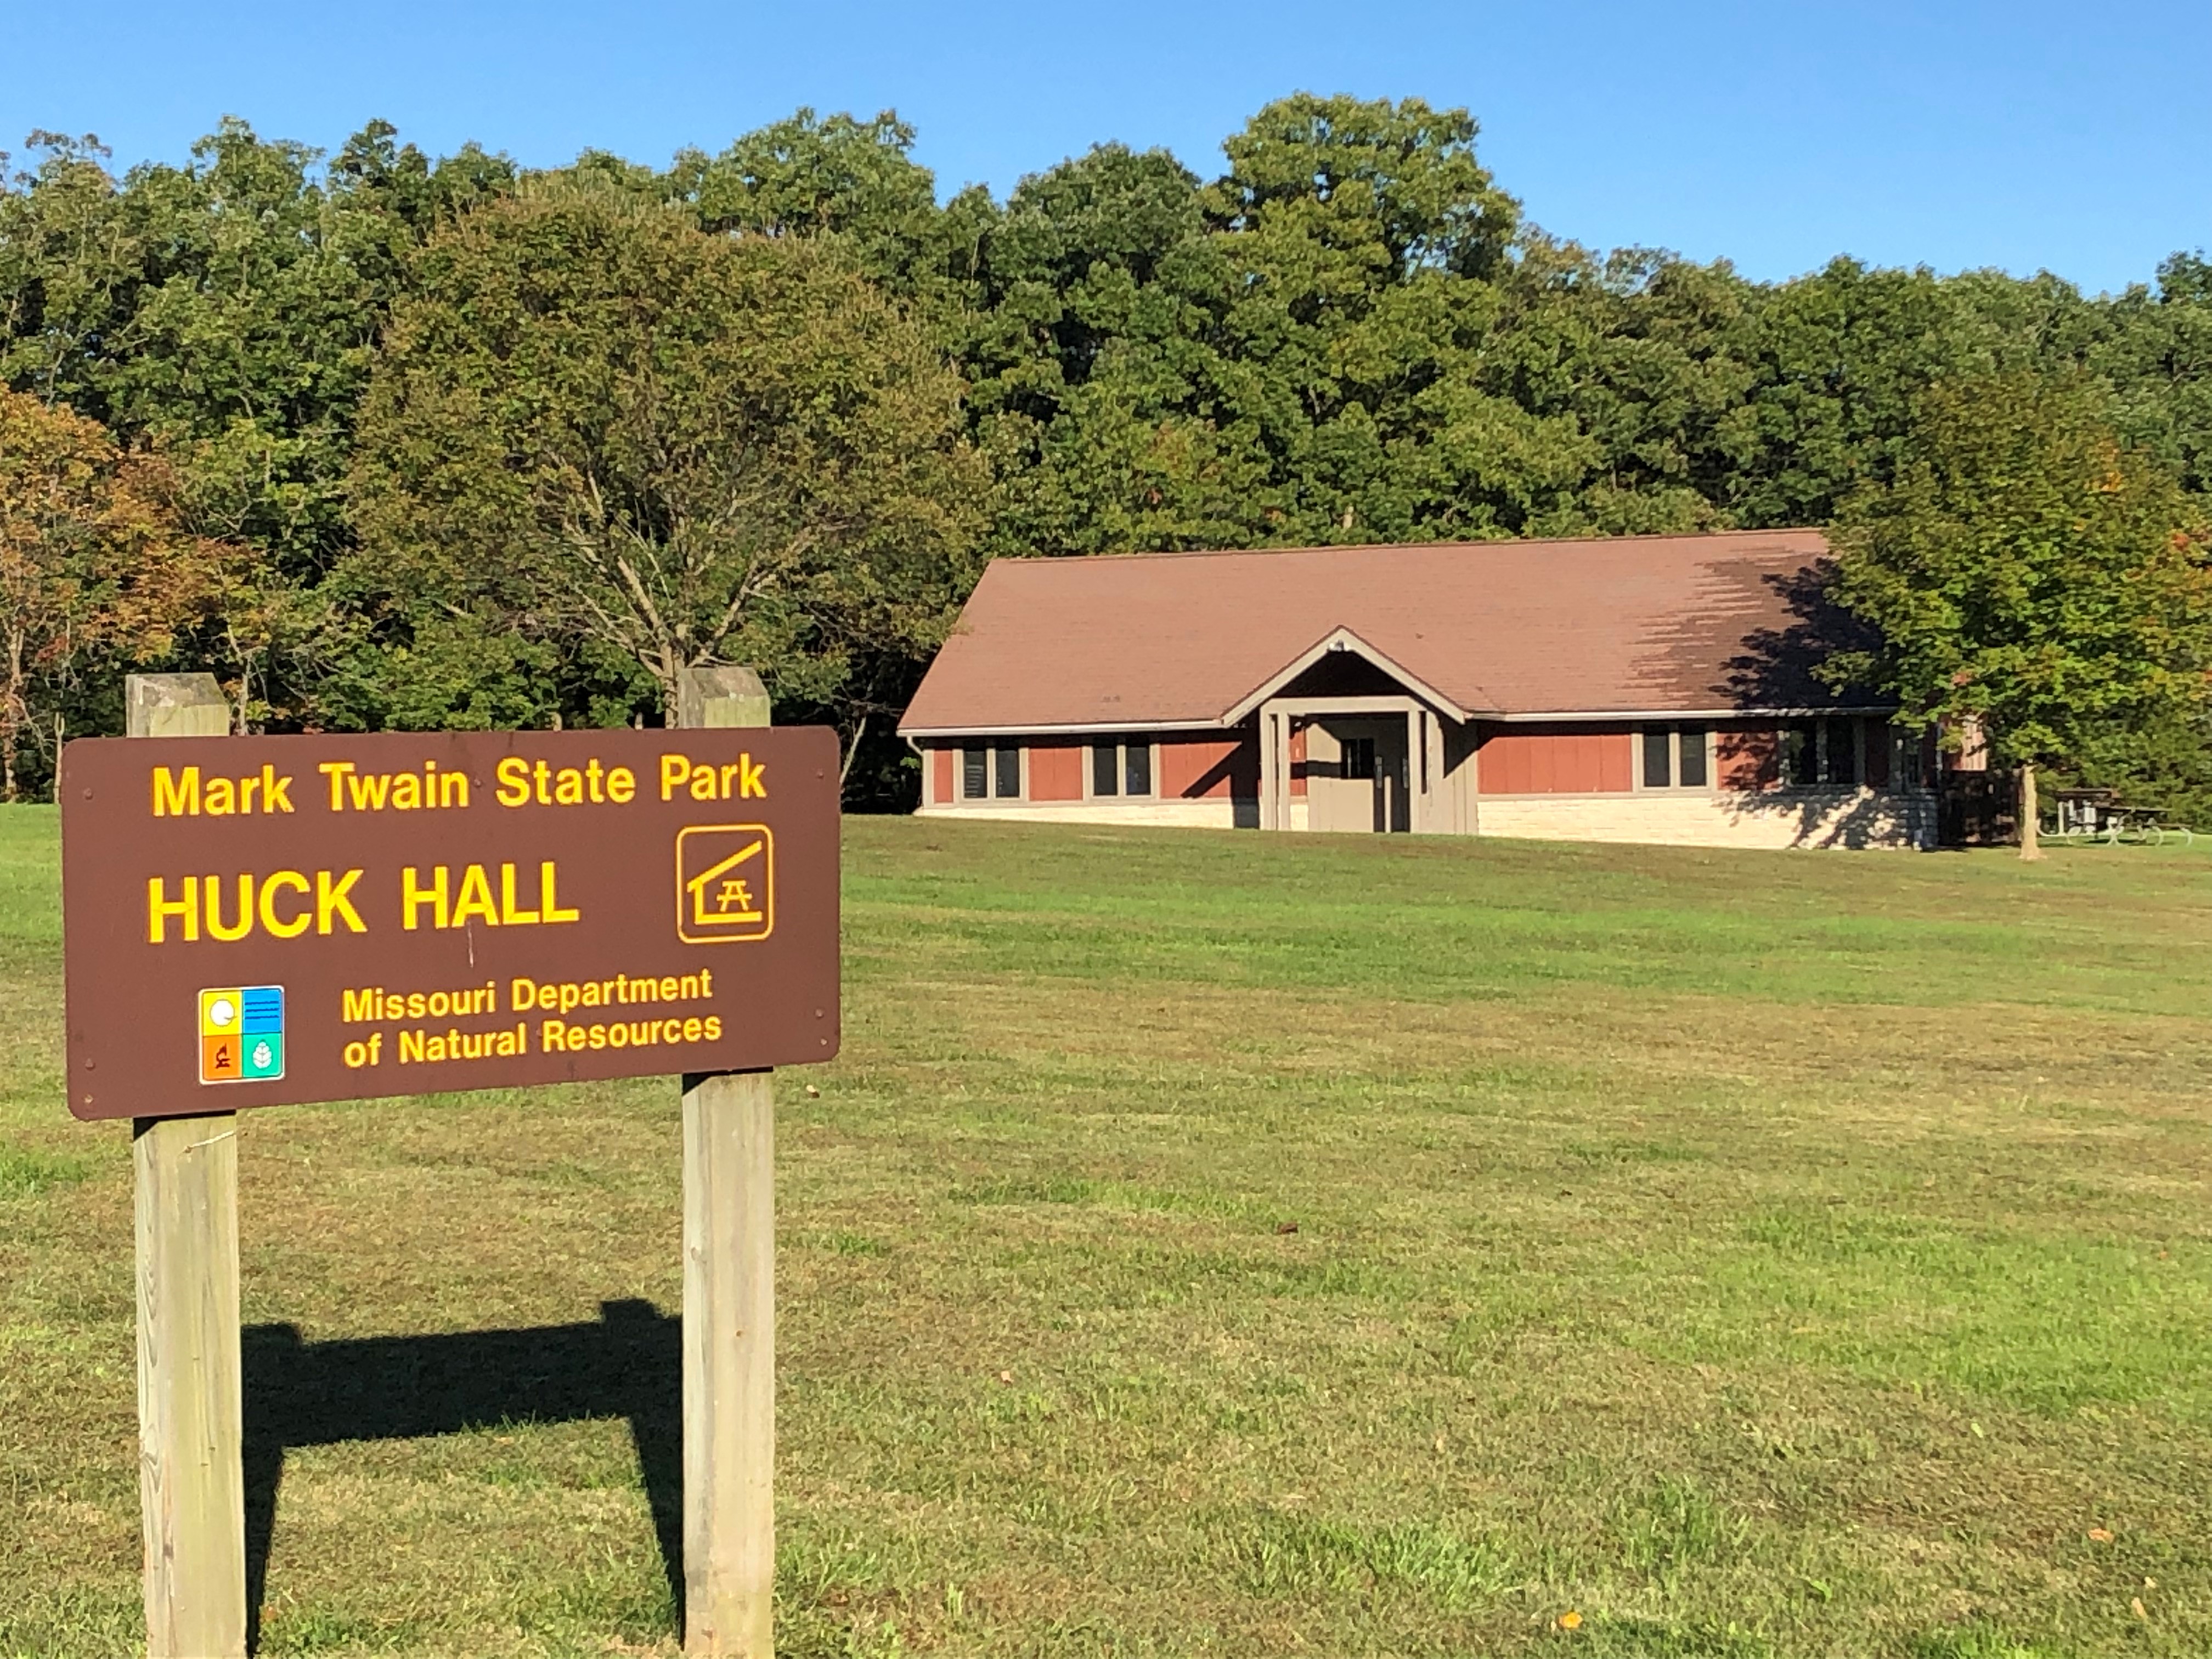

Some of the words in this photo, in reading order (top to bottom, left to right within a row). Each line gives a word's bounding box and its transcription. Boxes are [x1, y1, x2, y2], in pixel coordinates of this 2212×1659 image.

[153, 764, 294, 816] Mark
[319, 760, 469, 811] Twain
[496, 757, 635, 806] State
[661, 753, 766, 800] Park
[148, 869, 367, 944] HUCK
[403, 861, 580, 930] HALL
[342, 980, 495, 1023] Missouri
[512, 969, 713, 1014] Department
[343, 1032, 383, 1068] of
[399, 1022, 526, 1063] Natural
[543, 1016, 722, 1053] Resources
